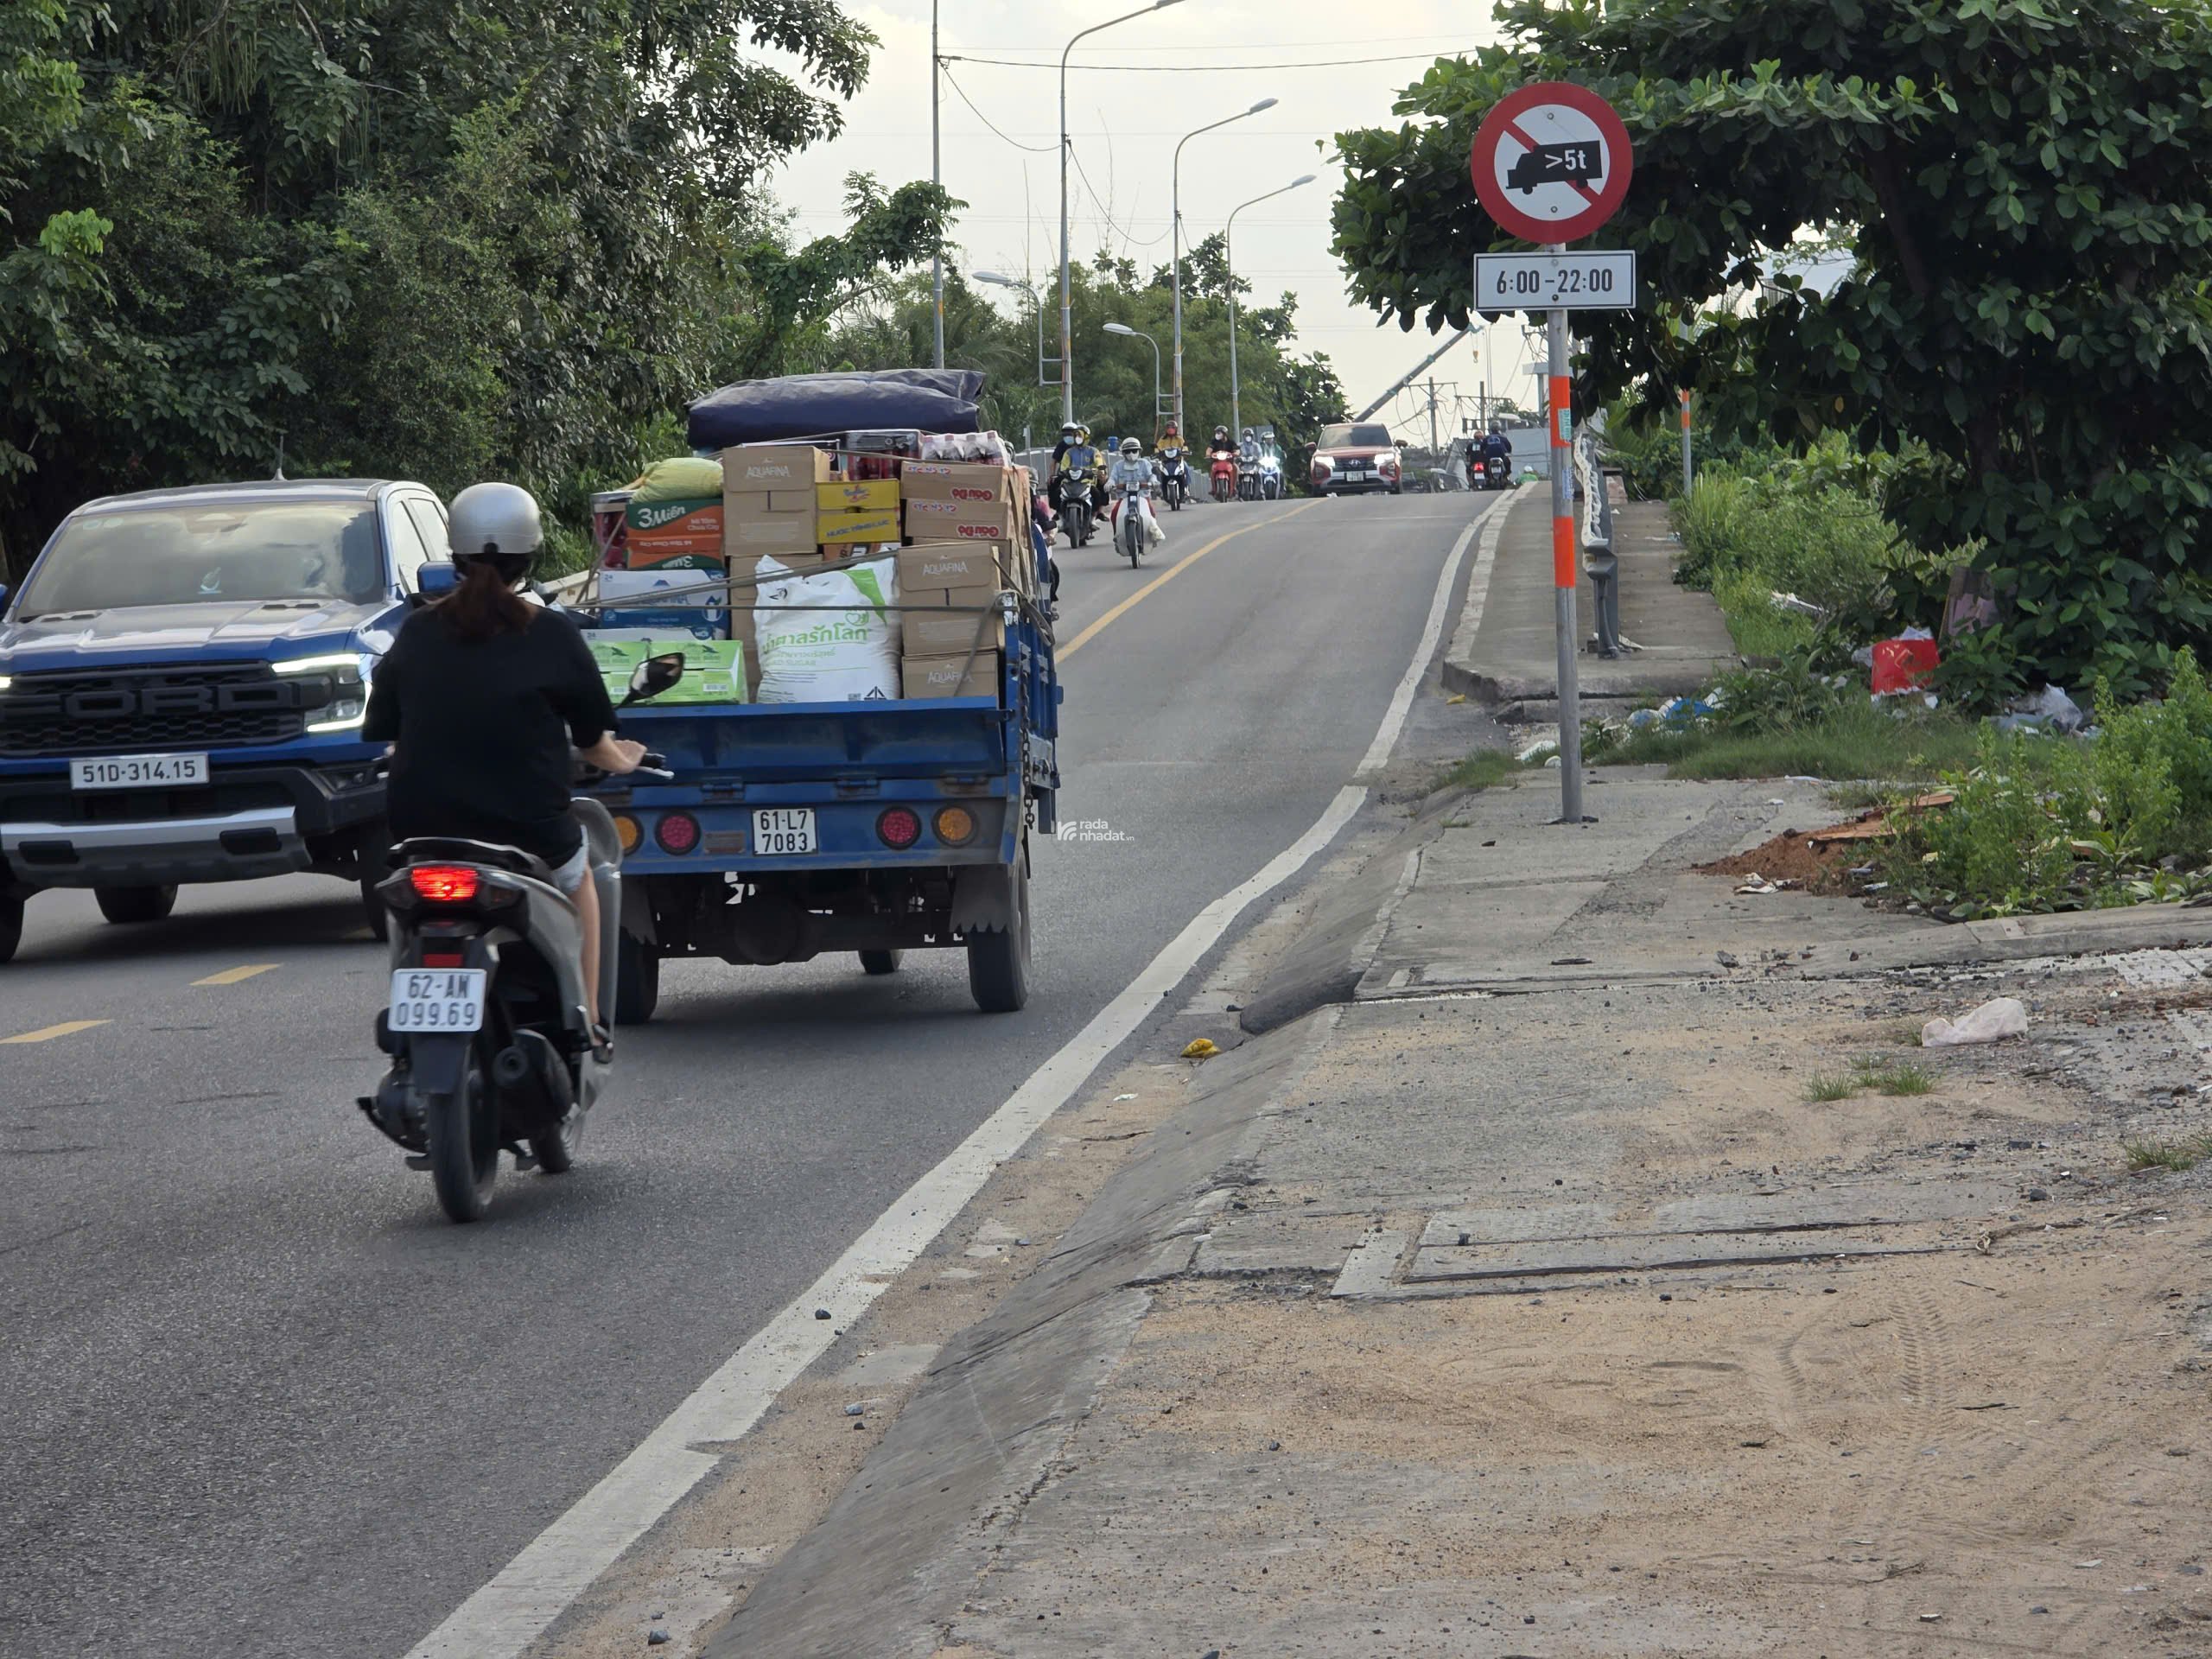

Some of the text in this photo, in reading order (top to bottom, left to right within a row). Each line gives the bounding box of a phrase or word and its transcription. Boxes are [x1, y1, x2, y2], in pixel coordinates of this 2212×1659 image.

[746, 465, 791, 479] AQUAFINA
[923, 561, 968, 575] AQUAFINA
[760, 810, 807, 831] 61-L7
[761, 832, 807, 853] 7083
